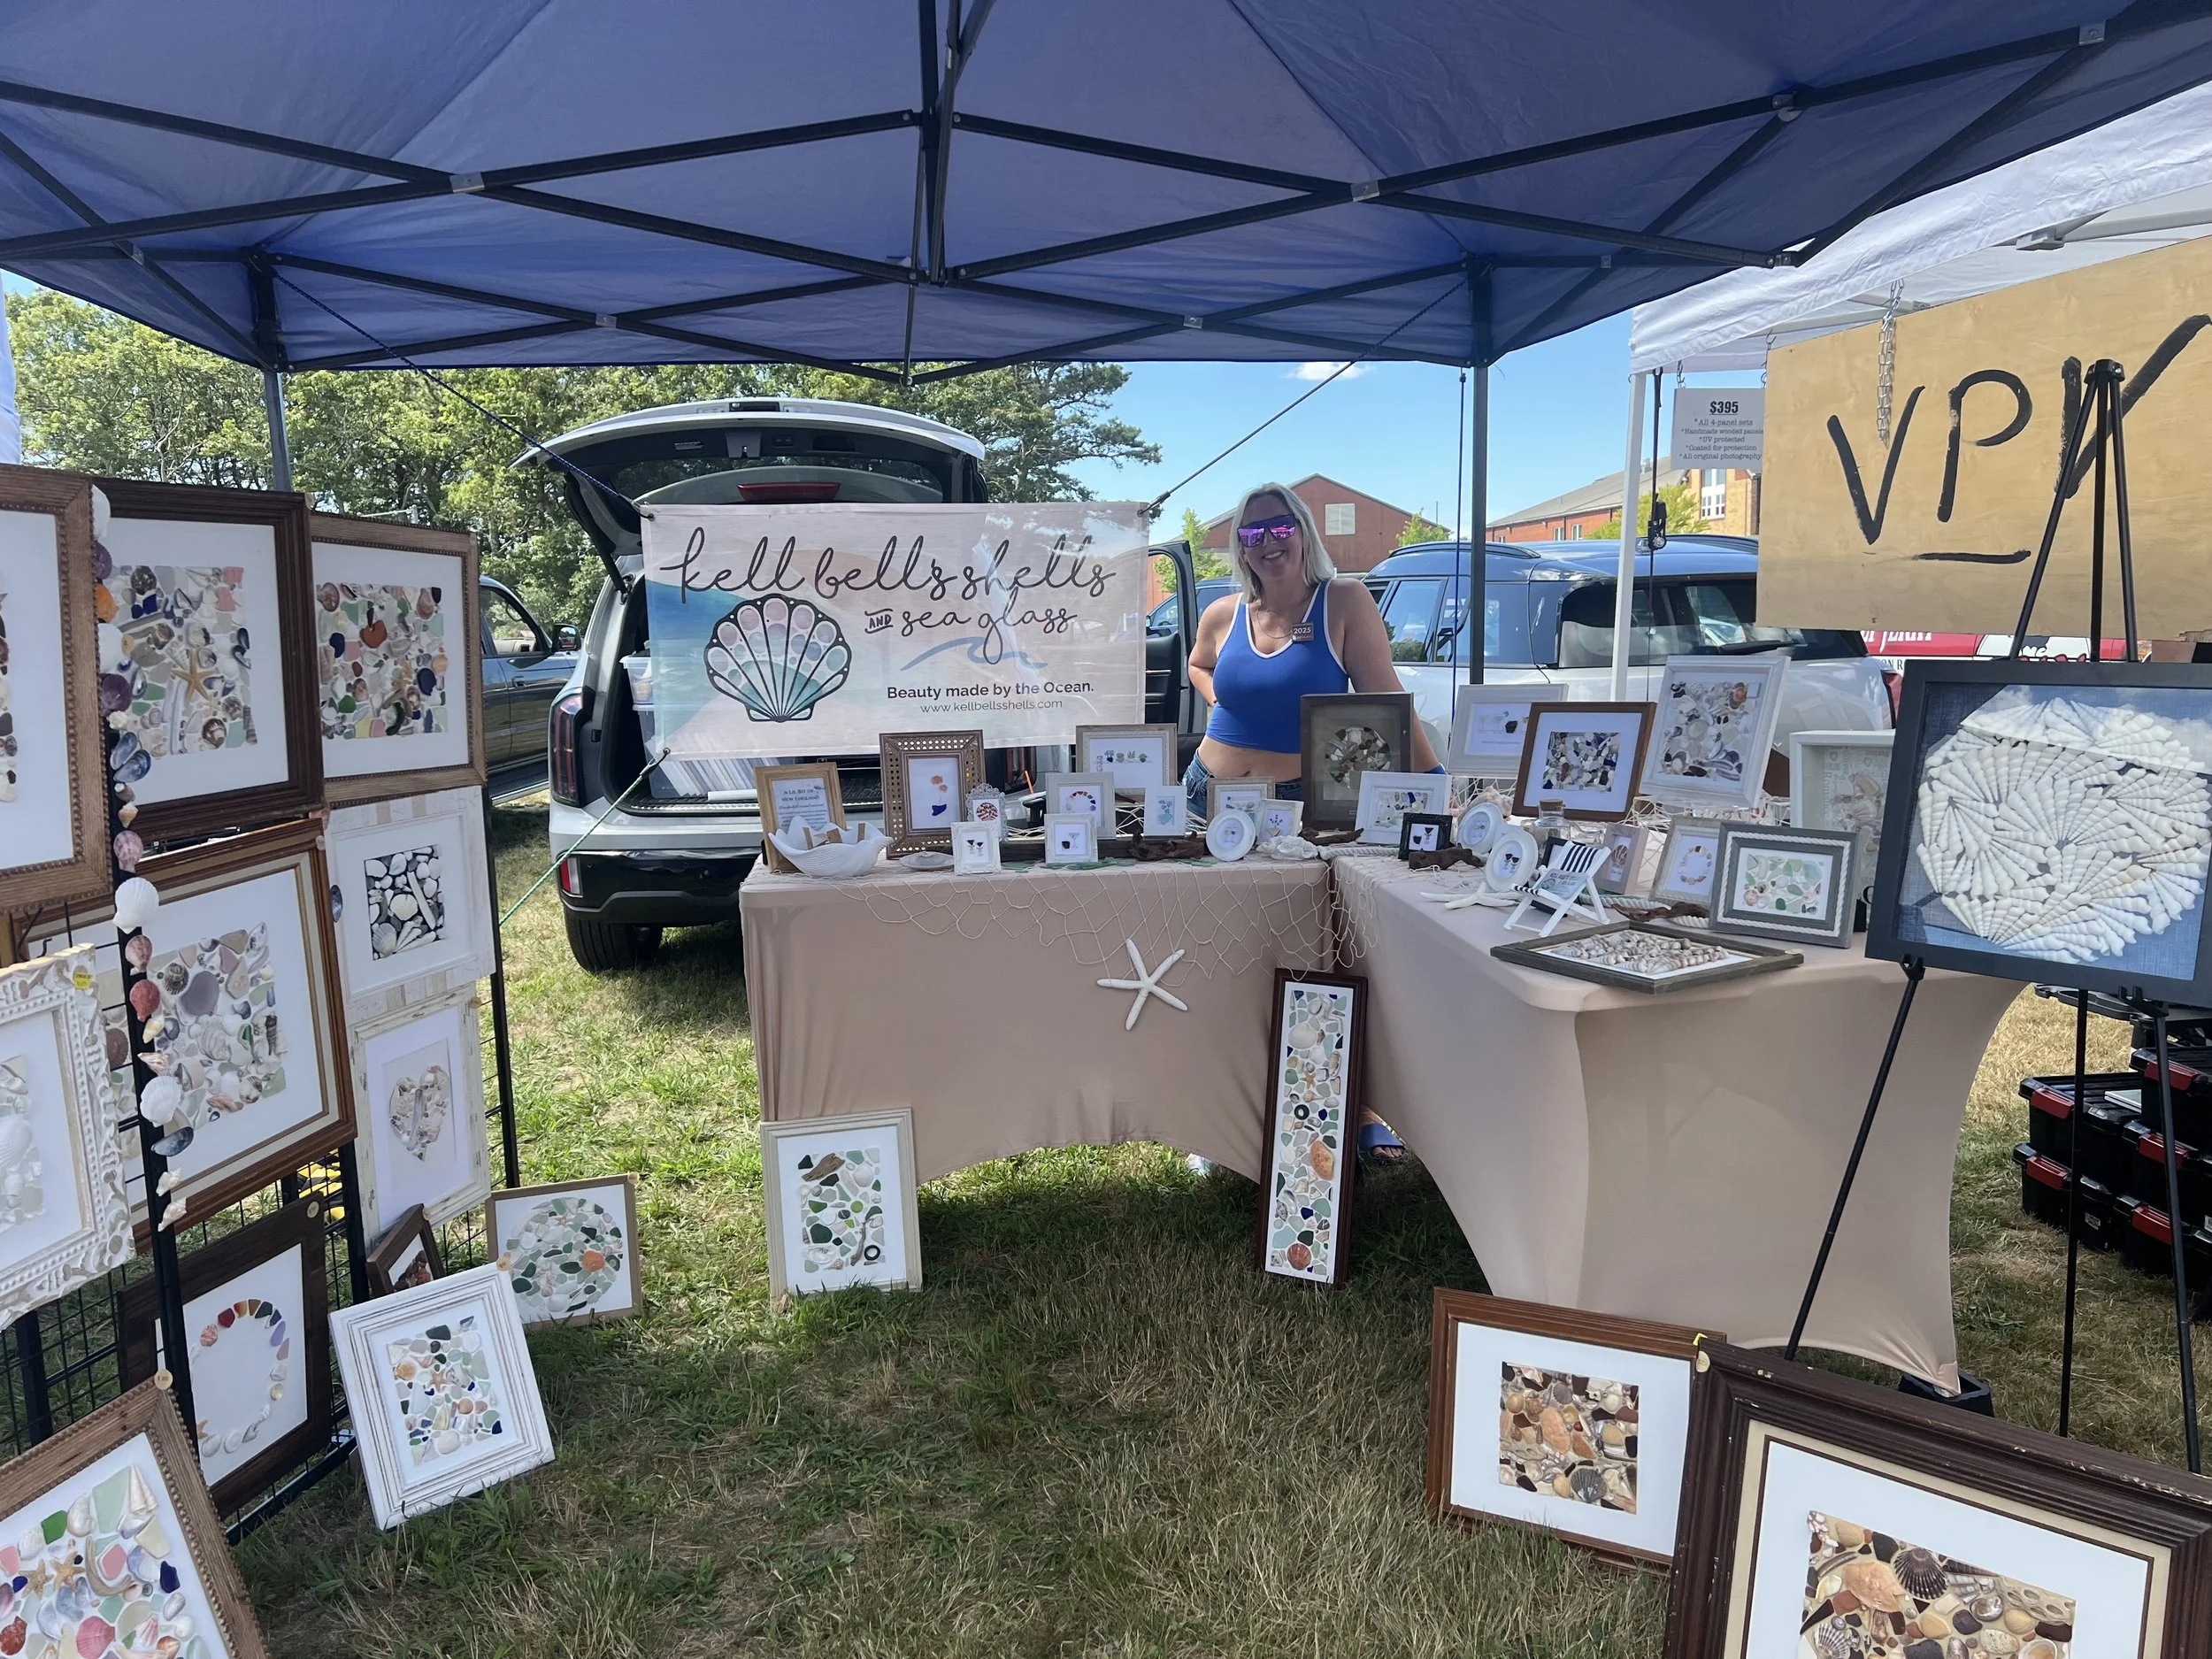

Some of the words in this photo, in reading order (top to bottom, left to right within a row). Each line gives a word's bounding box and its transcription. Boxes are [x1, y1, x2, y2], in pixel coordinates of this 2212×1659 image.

[1709, 401, 1739, 414] $395
[660, 526, 805, 603] kell
[961, 534, 1117, 601] shells
[869, 616, 892, 629] AND
[901, 611, 972, 637] sea
[978, 587, 1077, 664] glass
[887, 686, 941, 700] Beauty
[945, 684, 989, 697] made
[993, 683, 1011, 697] by
[1016, 682, 1040, 694] the
[1043, 681, 1094, 694] Ocean.
[920, 699, 1063, 713] www.kellbellsshells.com
